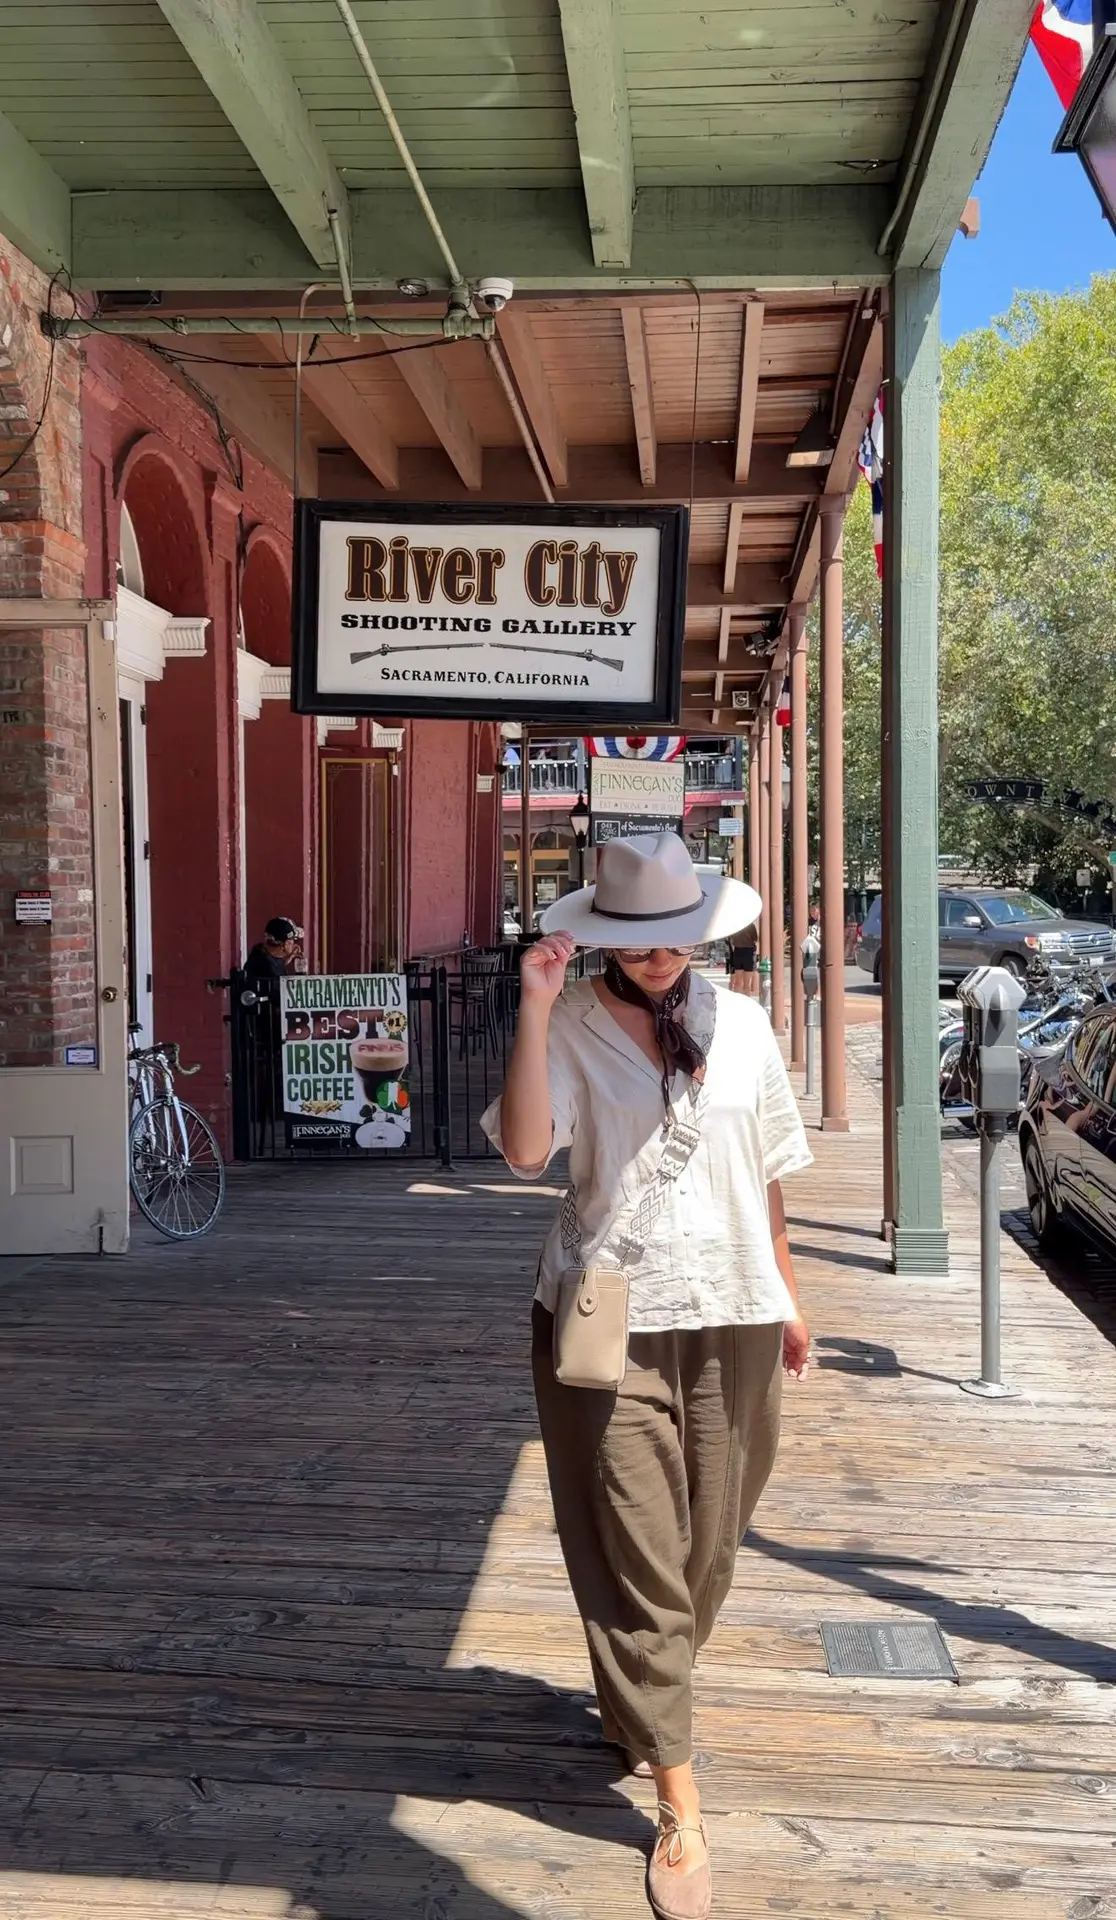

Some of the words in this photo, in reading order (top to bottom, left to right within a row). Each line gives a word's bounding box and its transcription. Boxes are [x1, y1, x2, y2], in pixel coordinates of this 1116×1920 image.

[345, 535, 505, 605] River
[524, 539, 638, 617] City
[341, 614, 491, 632] SHOOTING
[502, 619, 637, 636] GALLERY
[381, 667, 492, 684] SACRAMENTO,
[494, 670, 590, 687] CALIFORNIA
[599, 773, 683, 796] FINNEGAN'S
[620, 821, 628, 831] of
[628, 821, 665, 832] Sacramento's
[665, 823, 677, 832] Best
[286, 977, 401, 1009] SACRAMENTO'S
[285, 1009, 385, 1040] BEST
[387, 1017, 401, 1027] #1
[287, 1043, 352, 1075] IRISH
[287, 1078, 354, 1102] COFFEE
[296, 1125, 350, 1137] FINNEGAN'S
